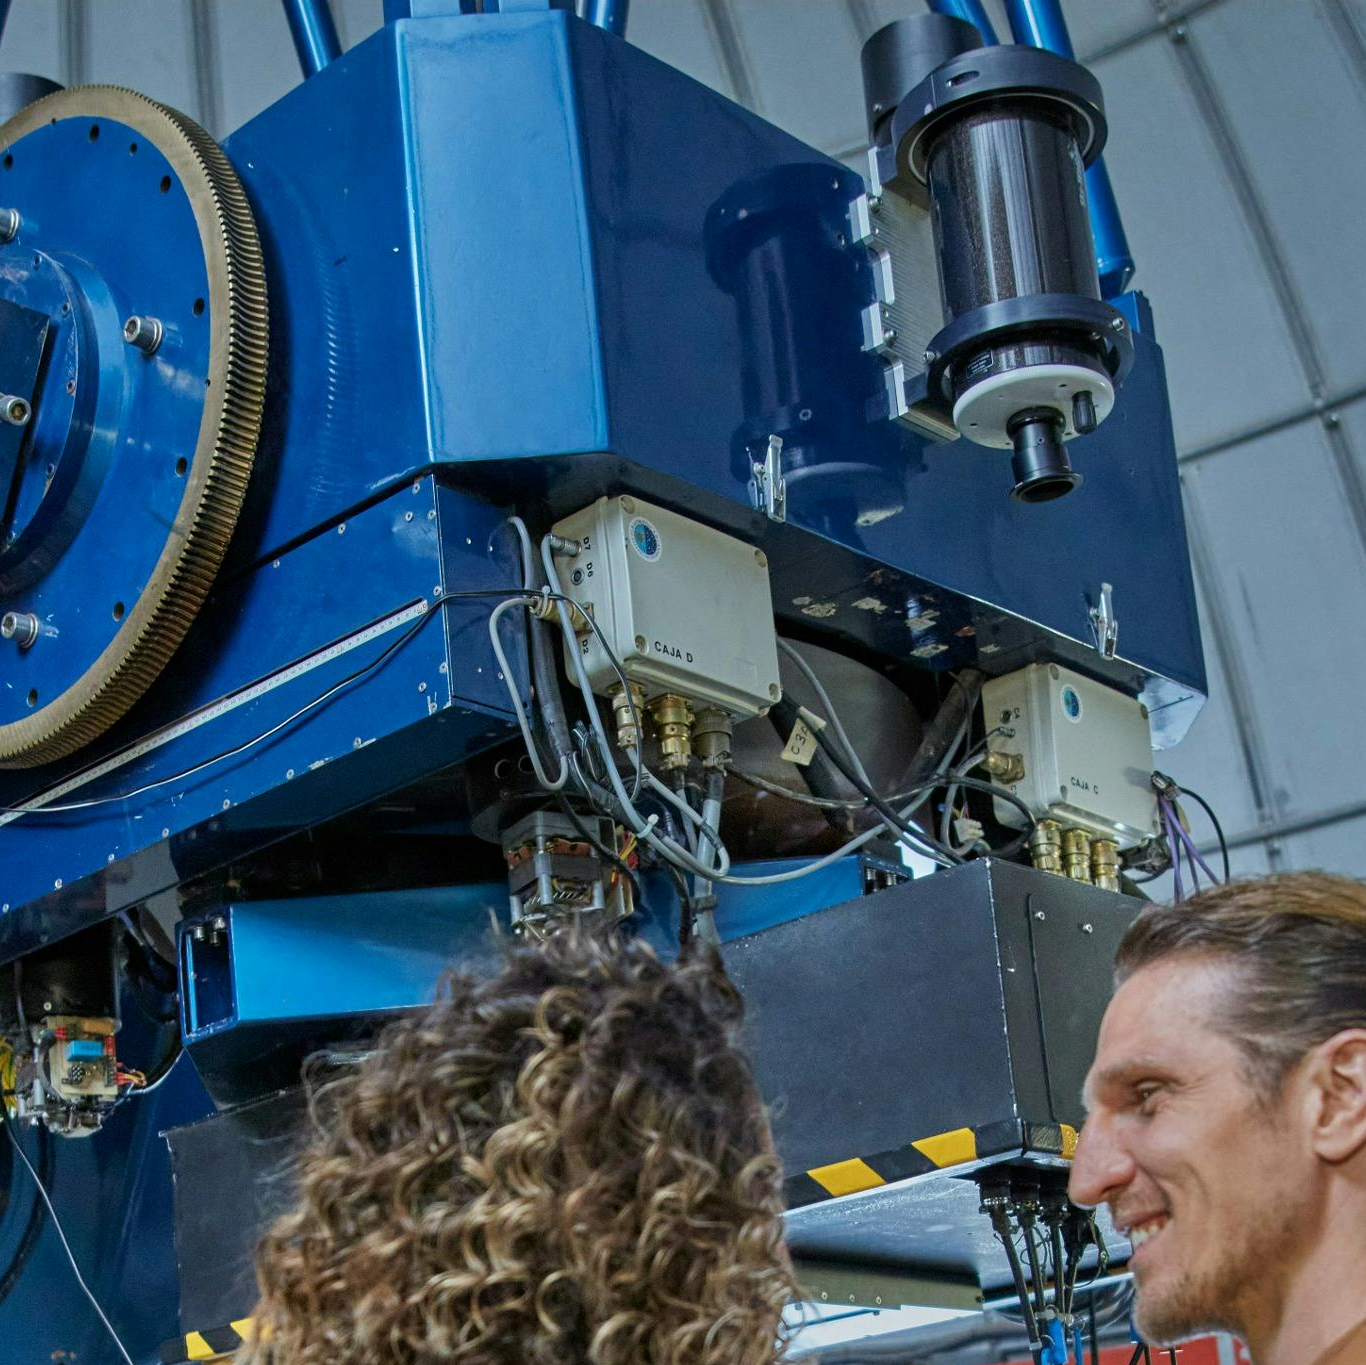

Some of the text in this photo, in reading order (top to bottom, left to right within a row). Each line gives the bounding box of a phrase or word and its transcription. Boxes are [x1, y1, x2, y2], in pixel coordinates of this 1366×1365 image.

[583, 536, 591, 550] D7
[582, 639, 589, 655] D2
[654, 641, 694, 663] CAJA D
[1070, 776, 1099, 794] CAJA C
